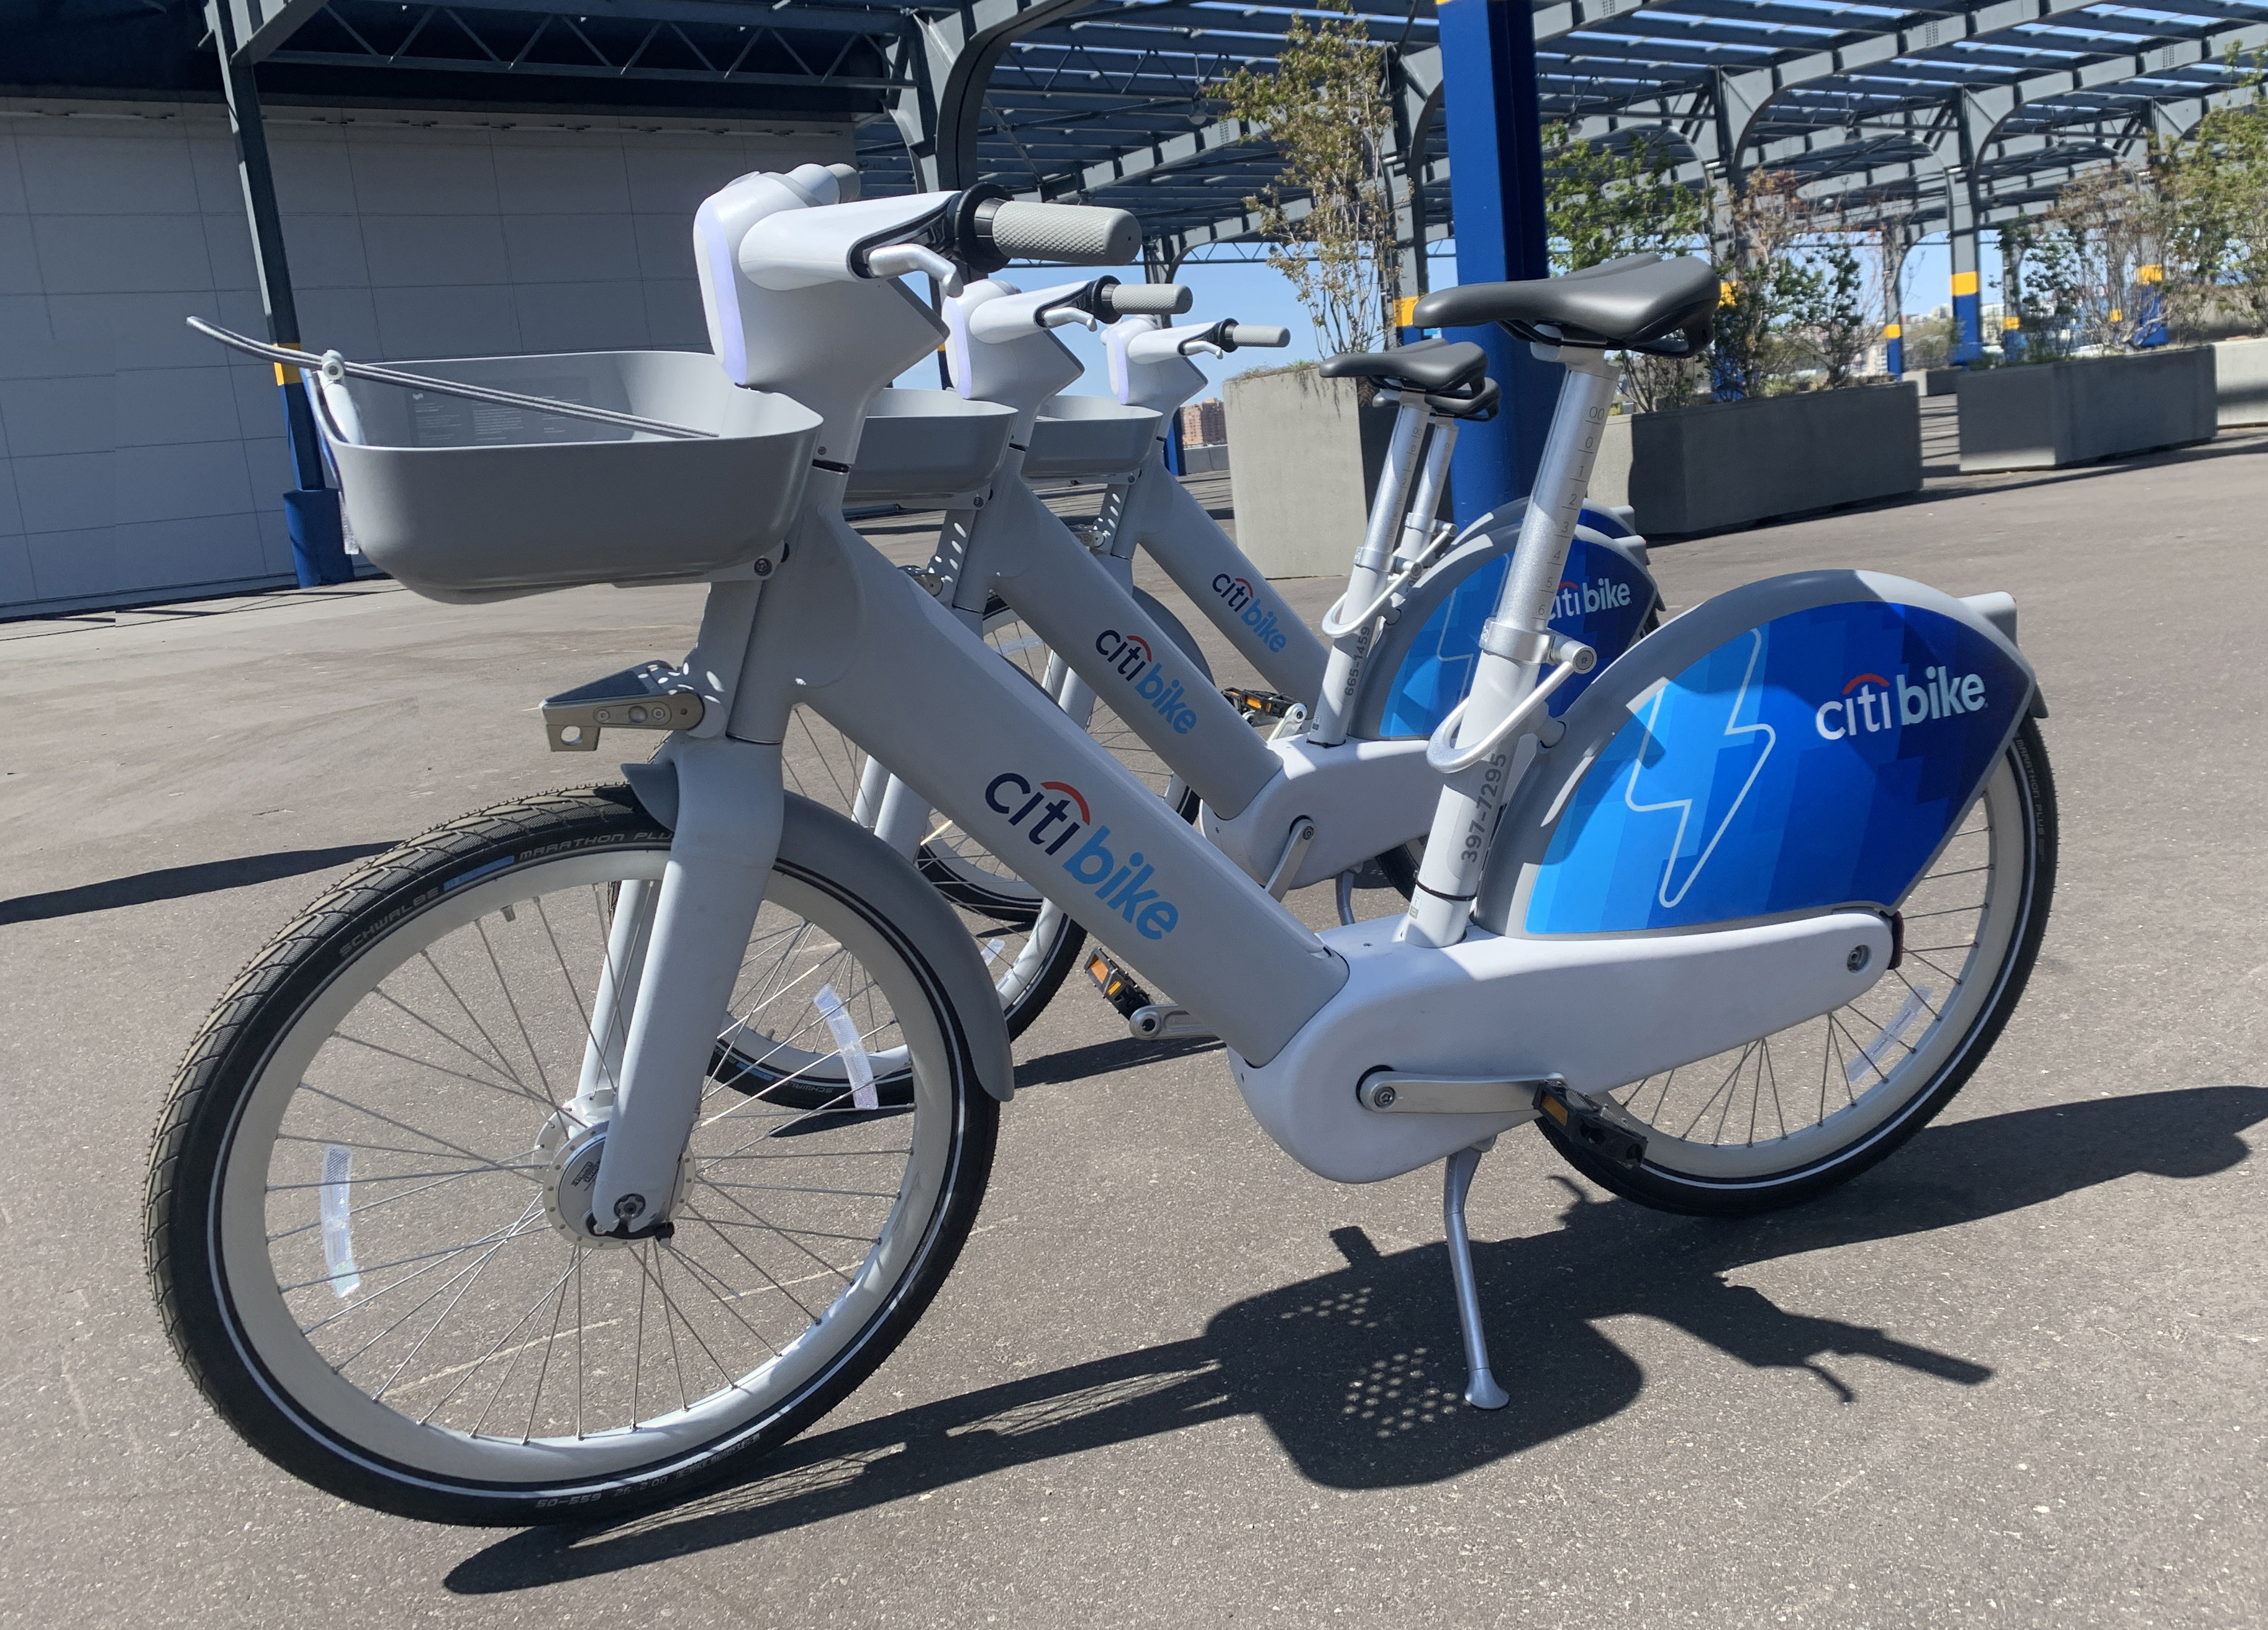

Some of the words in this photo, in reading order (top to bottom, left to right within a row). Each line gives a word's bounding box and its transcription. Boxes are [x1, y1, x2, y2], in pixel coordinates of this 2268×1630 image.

[1589, 406, 1605, 420] 00
[1585, 436, 1594, 448] 0
[1579, 465, 1585, 478] 1
[1569, 493, 1577, 506] 2
[1561, 521, 1569, 533] 3
[1553, 549, 1561, 561] 4
[1546, 576, 1553, 589] 5
[1582, 578, 1631, 613] bike
[1212, 573, 1250, 613] citi
[1241, 599, 1287, 653] bike
[1538, 604, 1546, 616] 6
[1344, 626, 1371, 697] 665-1459
[1095, 629, 1146, 682] citi
[1134, 663, 1197, 734] bike
[1815, 683, 1892, 741] citi
[1900, 666, 1987, 725] bike
[1461, 753, 1507, 863] 397-7295
[519, 833, 625, 861] MARATHON
[633, 831, 674, 840] PLU
[985, 772, 1081, 856] citi
[1062, 825, 1179, 940] bike
[340, 886, 439, 955] SCHWALBE
[535, 1493, 602, 1508] 50-559
